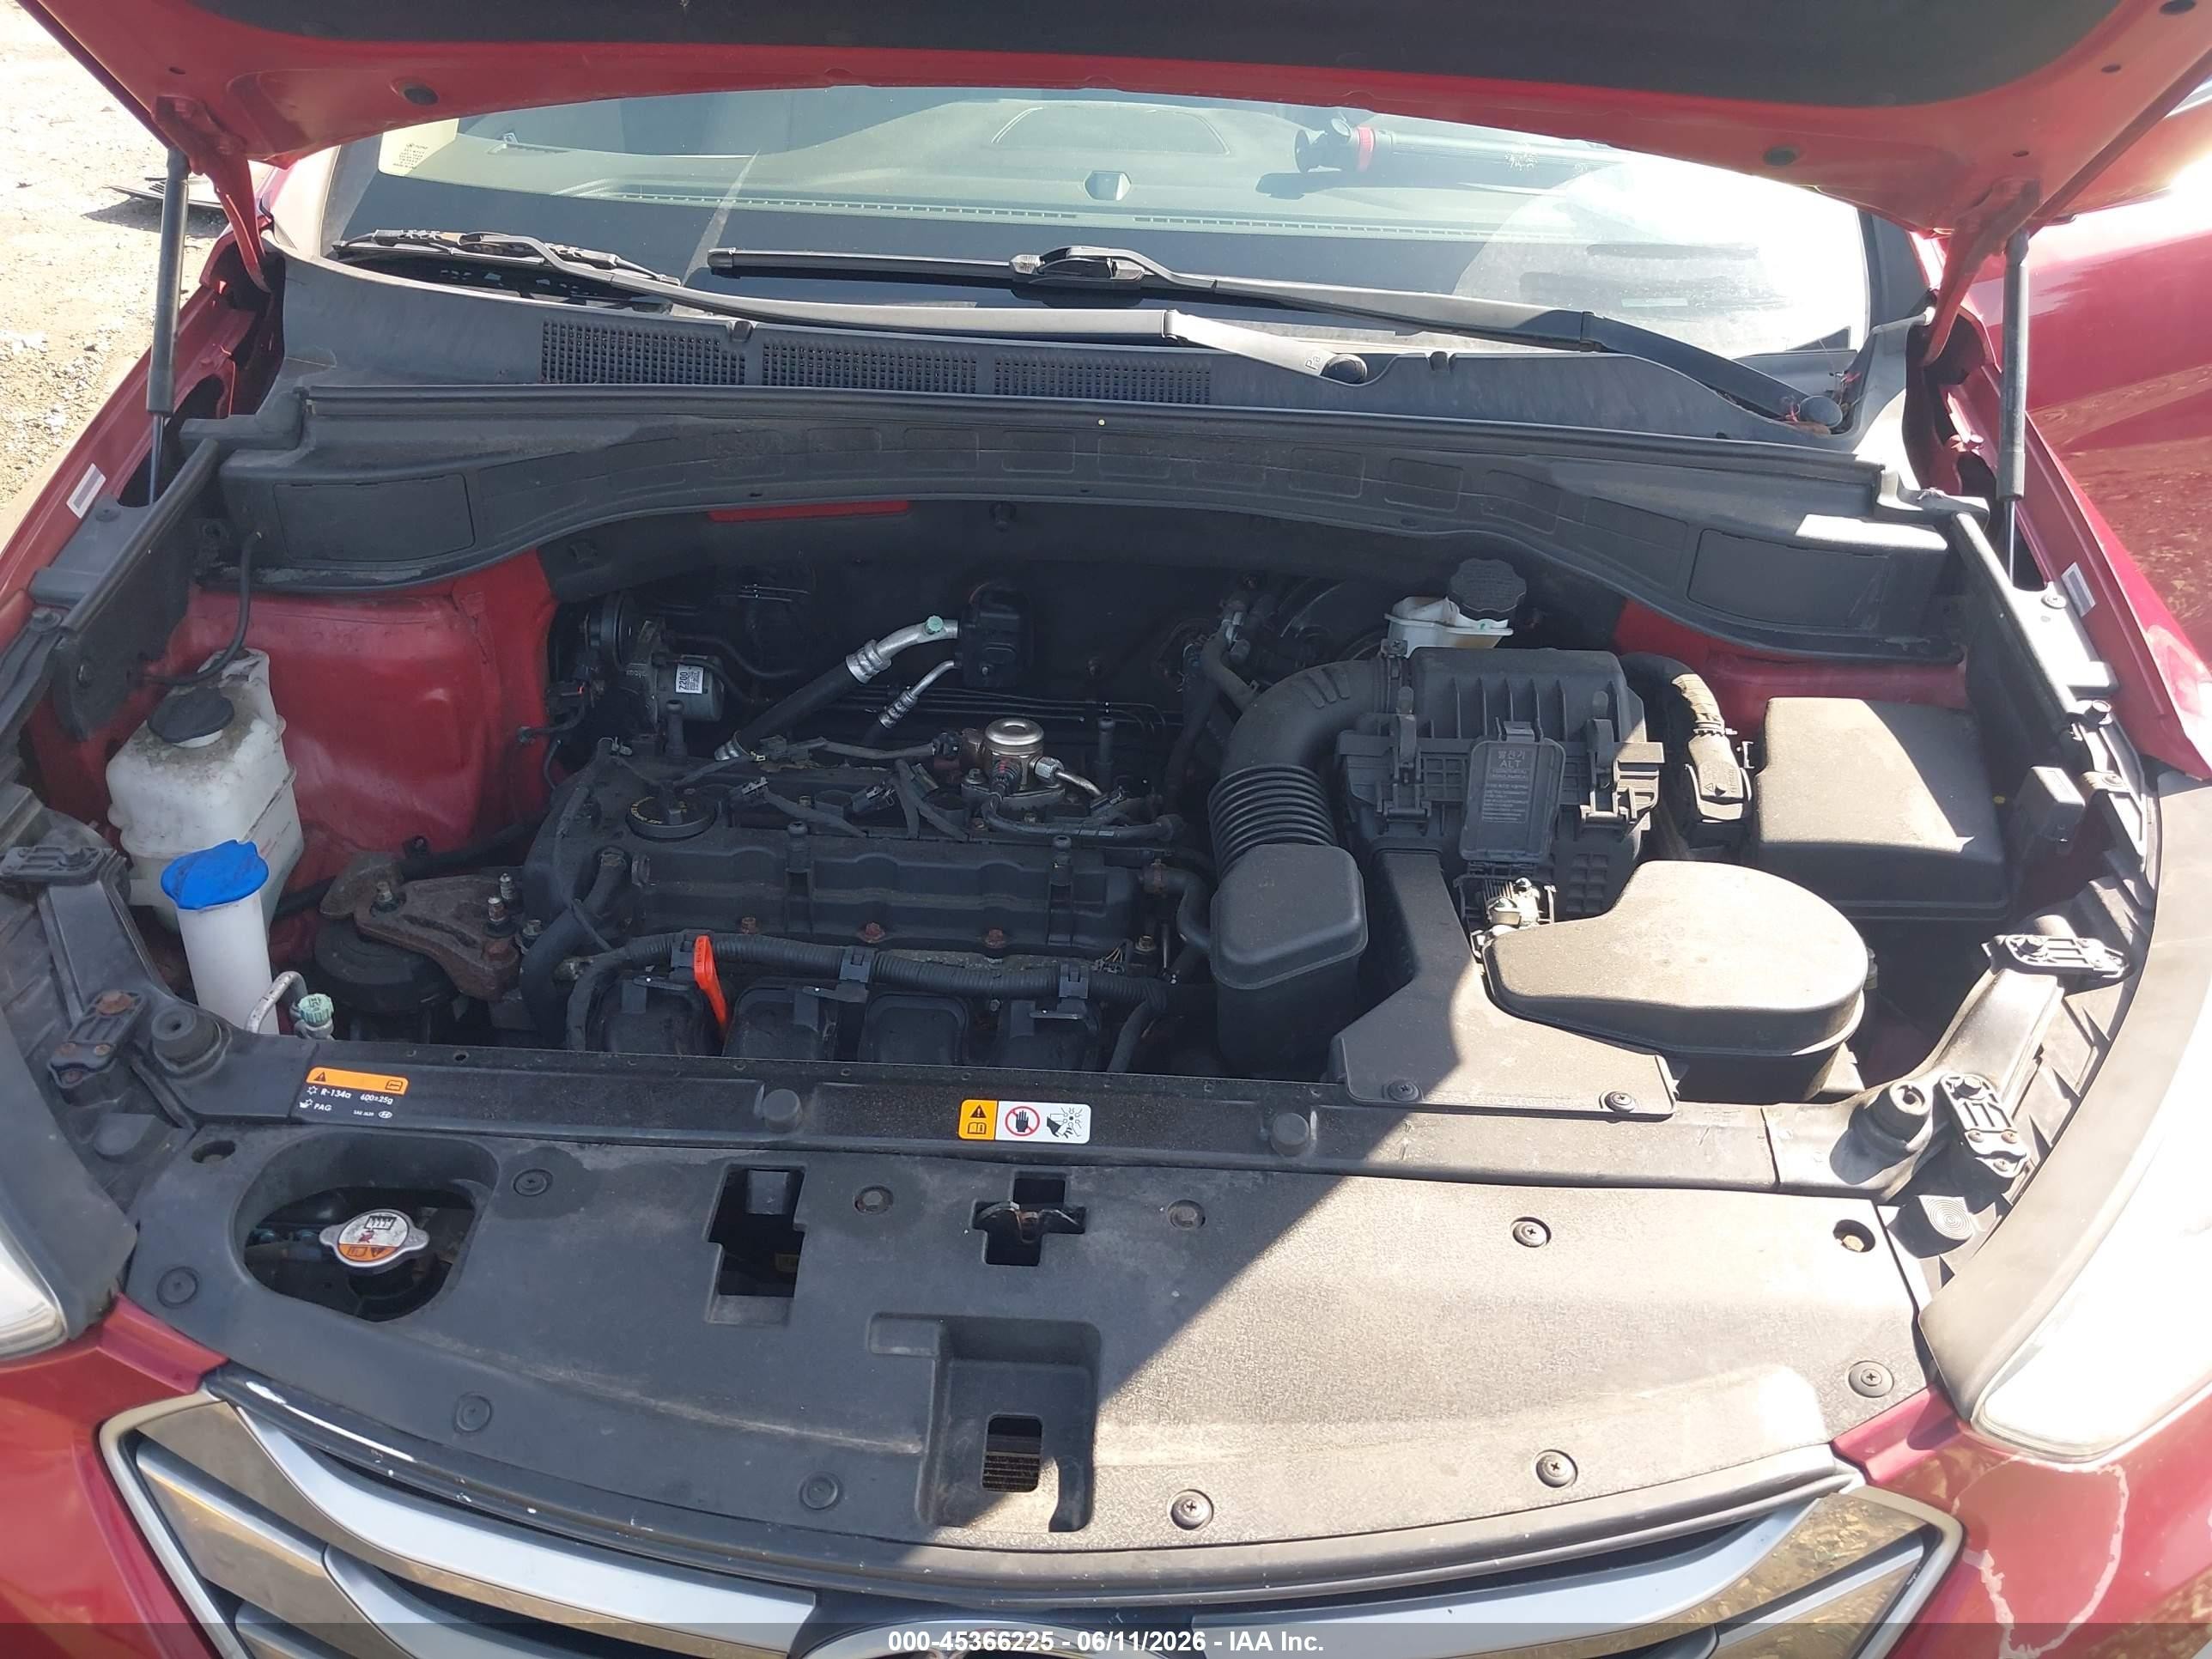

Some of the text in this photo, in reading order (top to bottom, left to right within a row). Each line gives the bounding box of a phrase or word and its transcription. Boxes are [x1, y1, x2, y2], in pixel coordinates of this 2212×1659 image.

[1499, 760, 1522, 769] ALT
[320, 1088, 352, 1099] R-134a
[313, 1103, 332, 1111] PAG
